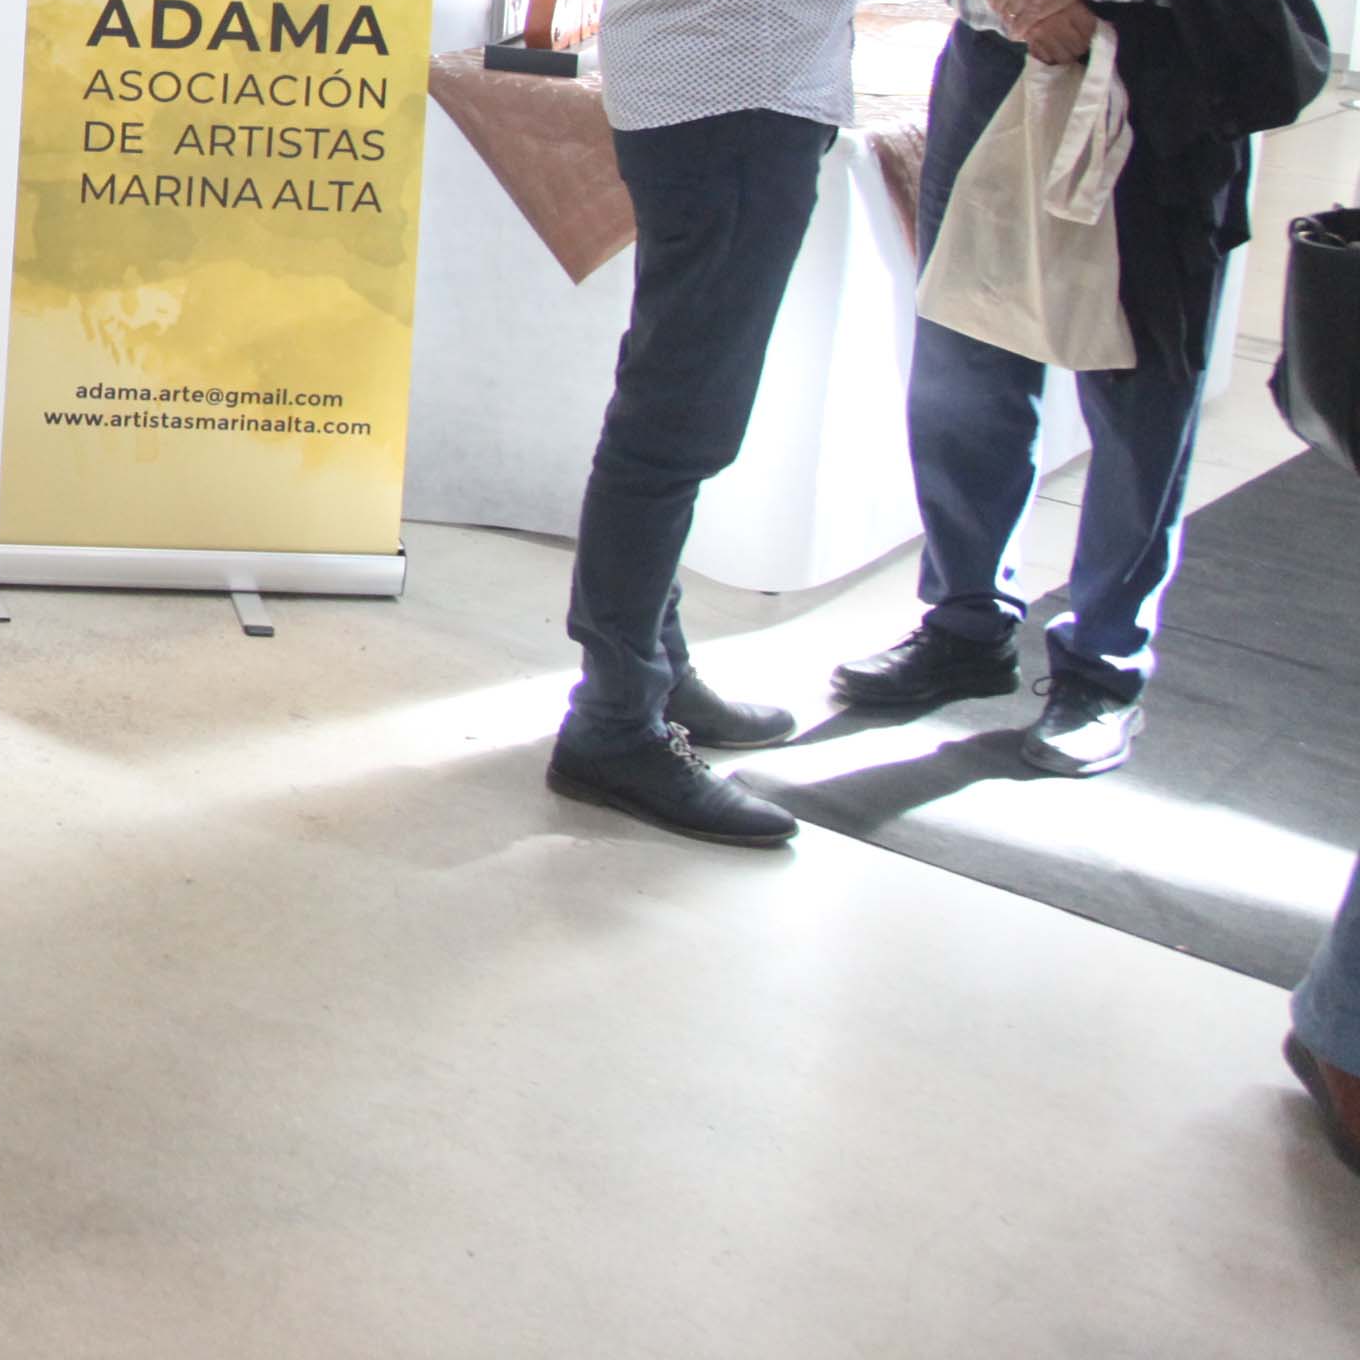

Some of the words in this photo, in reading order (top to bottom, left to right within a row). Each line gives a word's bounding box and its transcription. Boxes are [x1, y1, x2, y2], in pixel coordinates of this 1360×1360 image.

[82, 68, 388, 109] ASOCIACIÓN
[83, 120, 144, 154] DE
[173, 124, 386, 161] ARTISTAS
[75, 382, 344, 408] adama.arte@gmail.com
[43, 409, 372, 437] www.artistasmarinaalta.com
